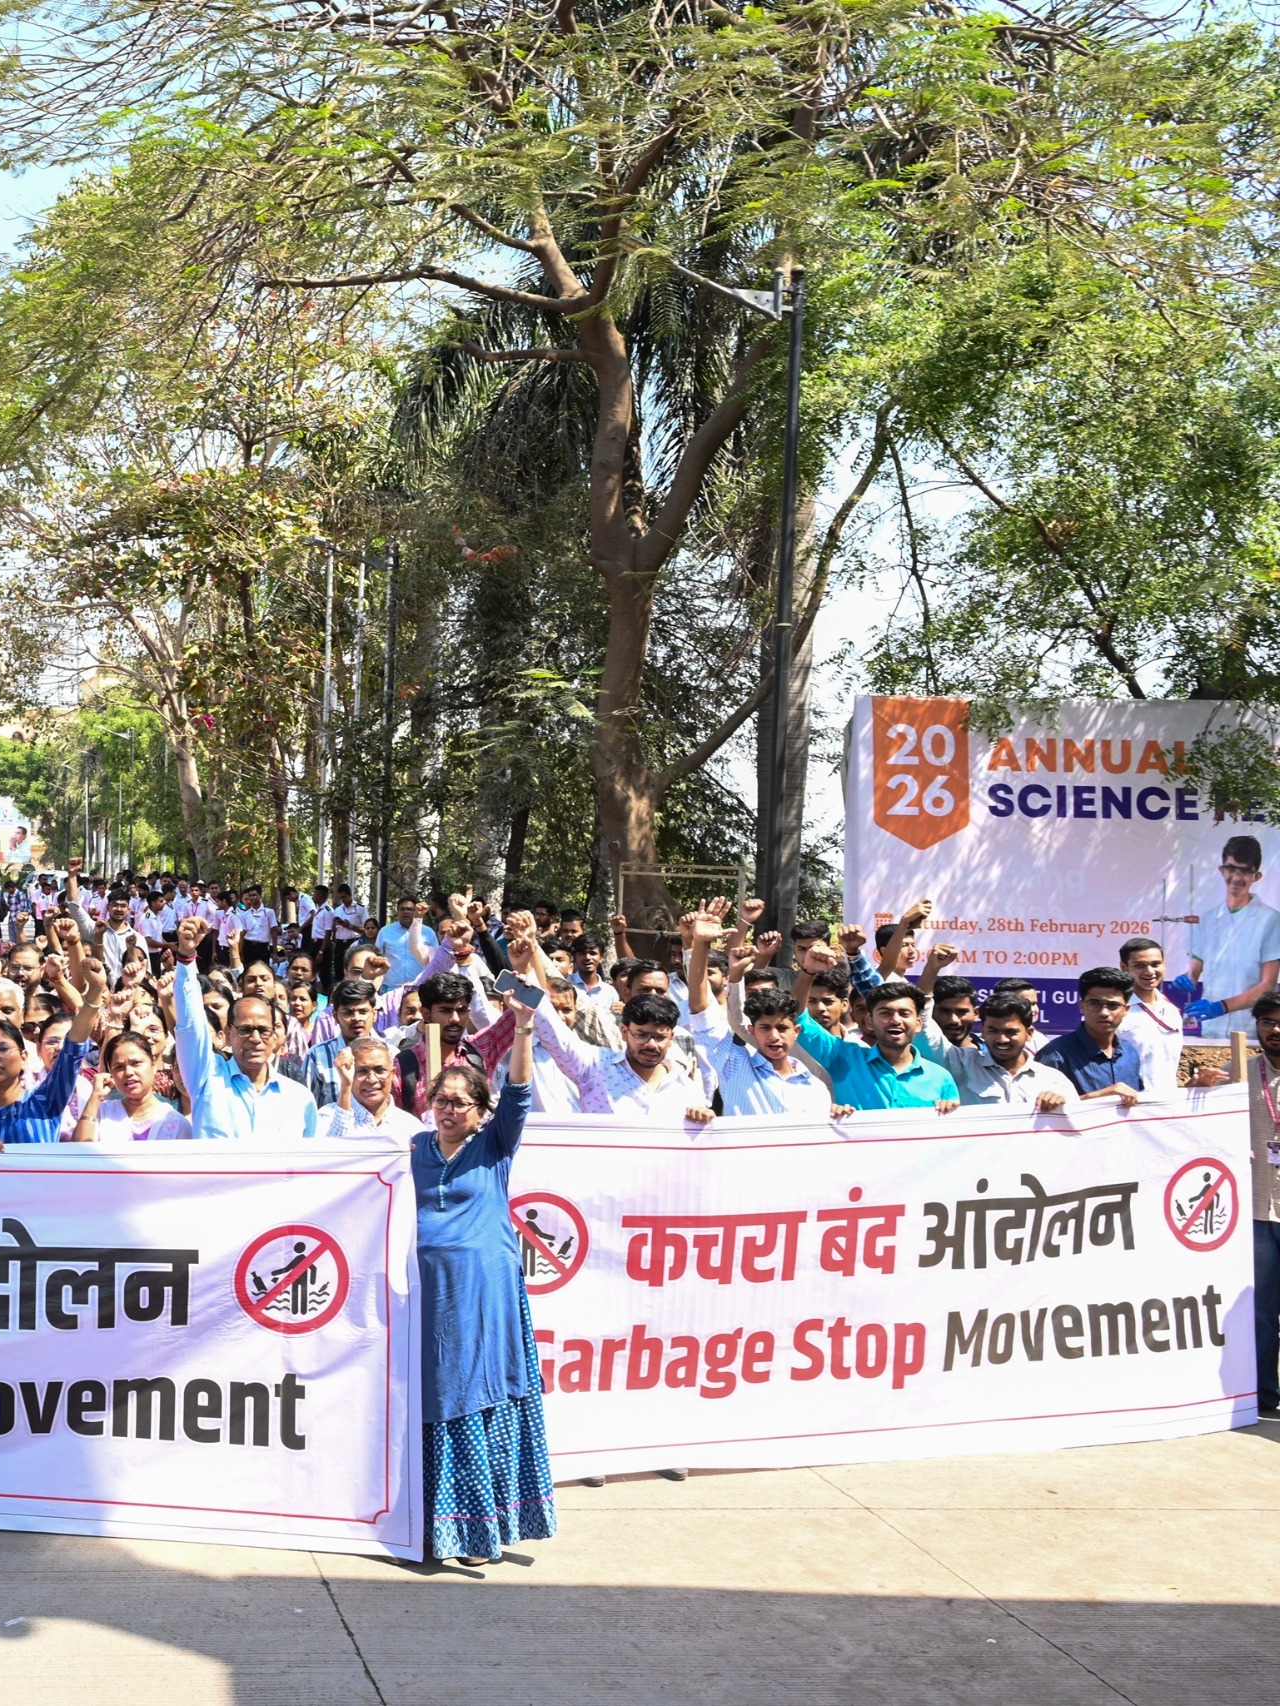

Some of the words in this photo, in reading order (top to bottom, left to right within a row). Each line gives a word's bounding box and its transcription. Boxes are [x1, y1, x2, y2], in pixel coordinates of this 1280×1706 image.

[886, 723, 956, 767] 20
[987, 737, 1200, 776] ANNUAL
[886, 773, 955, 817] 26
[988, 783, 1200, 821] SCIENCE
[921, 916, 984, 934] turday,
[987, 917, 1025, 932] 28th
[1029, 918, 1106, 938] February
[1110, 920, 1150, 935] 2026
[983, 950, 1008, 964] TO
[1013, 951, 1079, 966] 2:00PM
[621, 1211, 808, 1287] कचरा
[815, 1186, 906, 1277] बंद
[918, 1173, 1139, 1270] आंदोलन
[790, 1316, 927, 1390] Stop
[942, 1284, 1226, 1373] Movement
